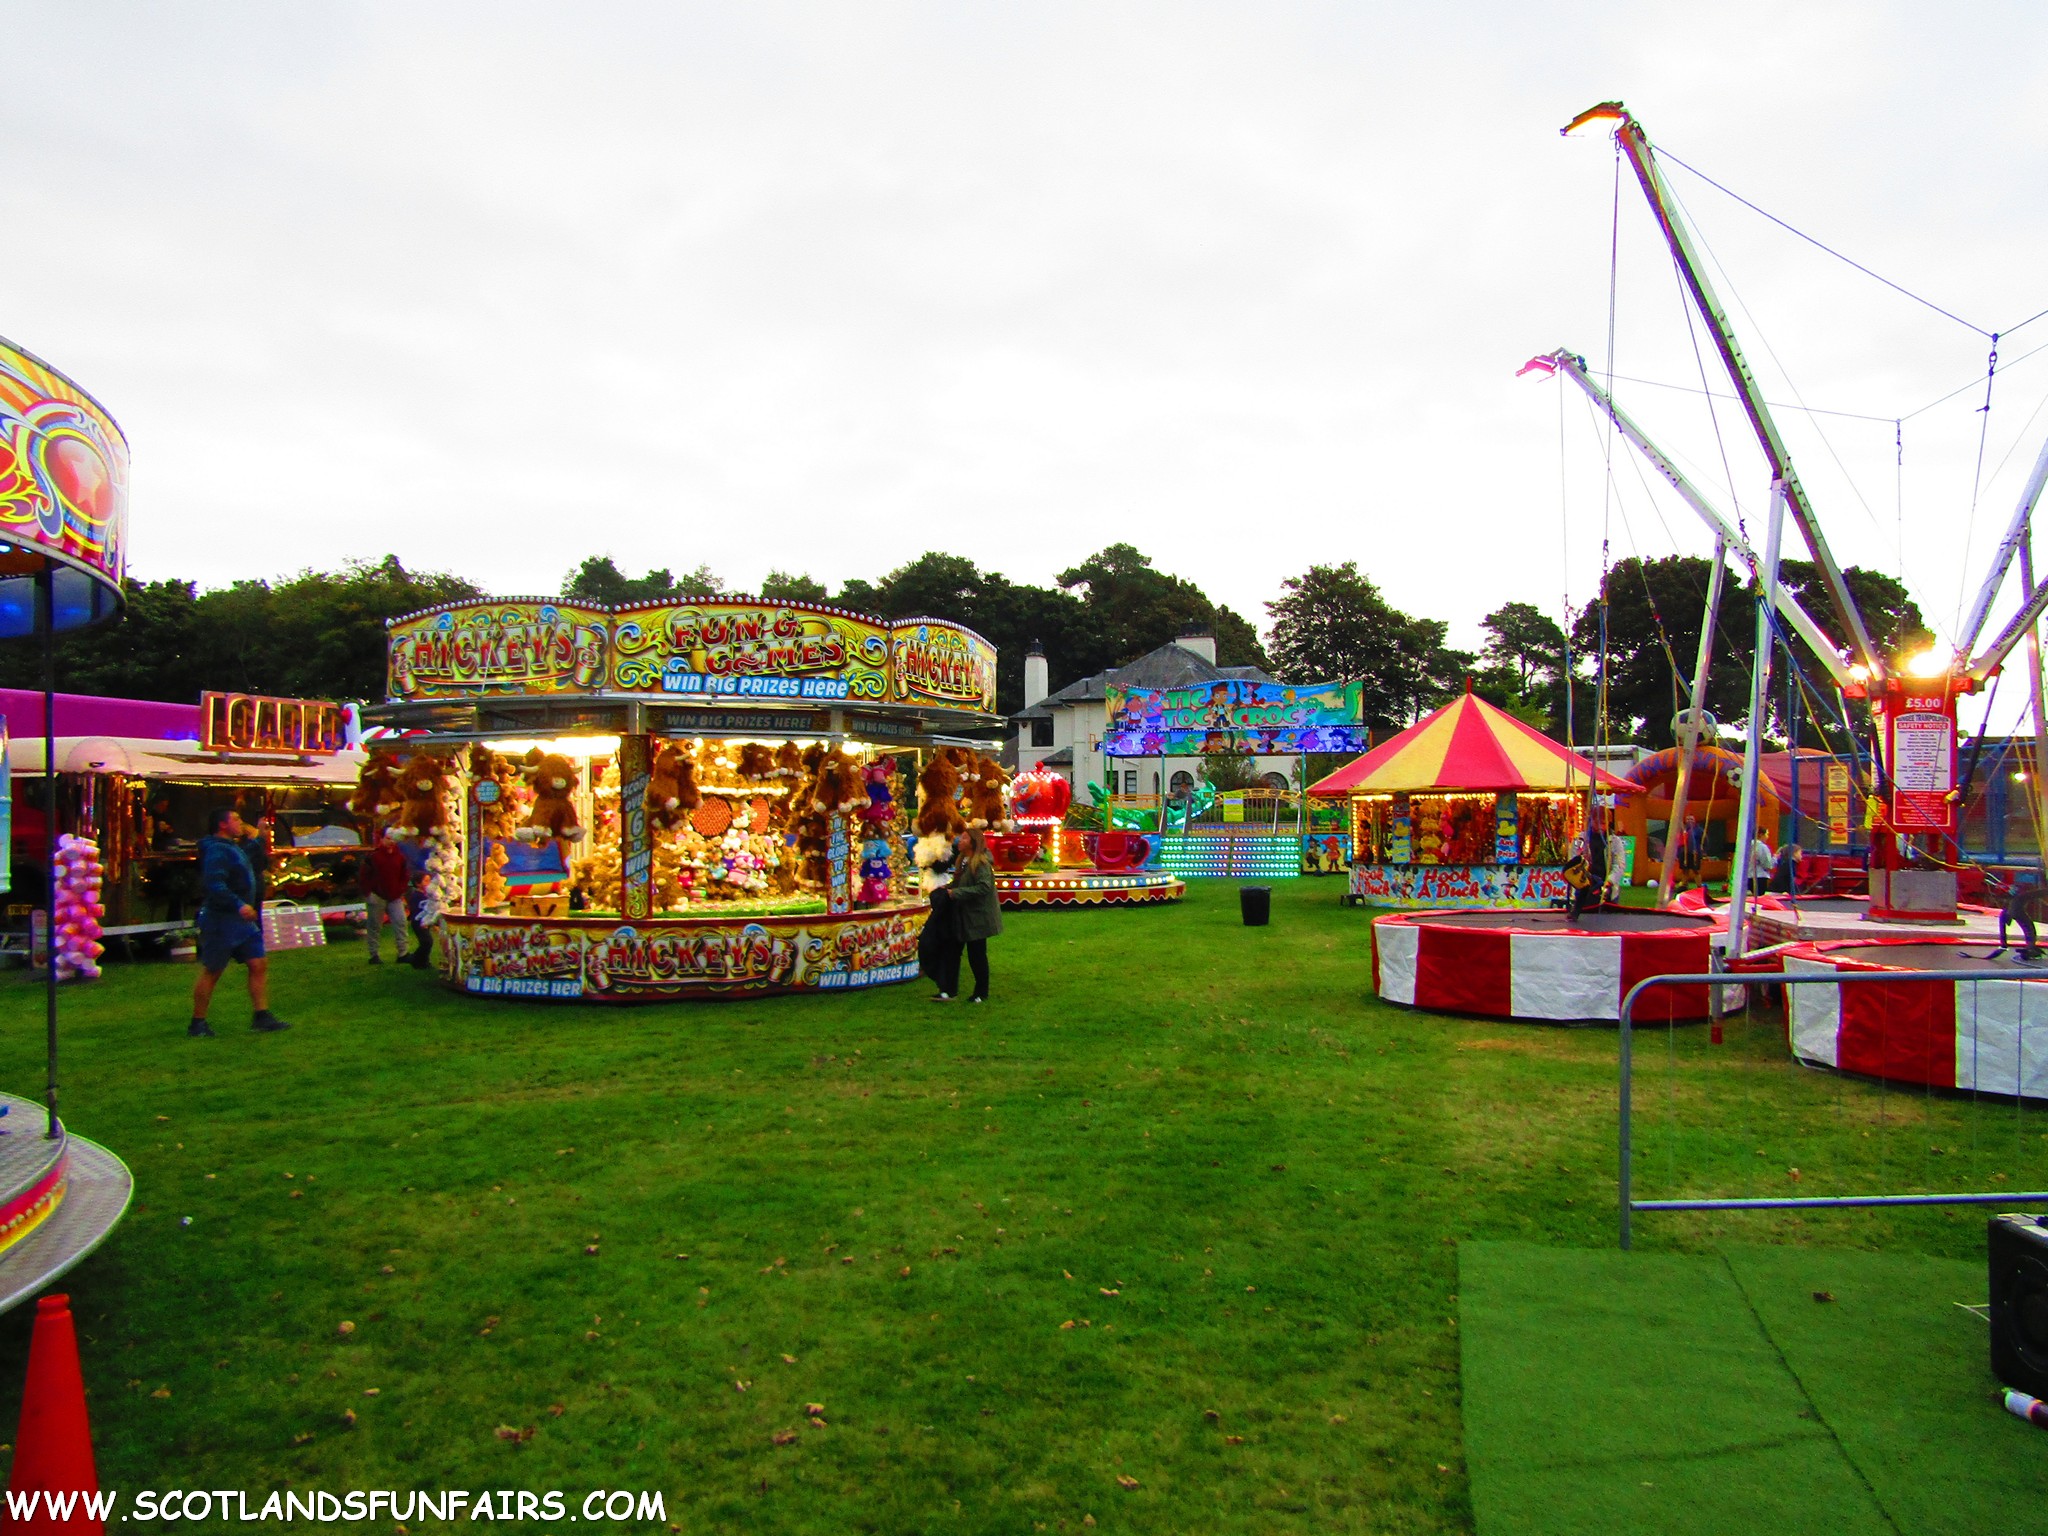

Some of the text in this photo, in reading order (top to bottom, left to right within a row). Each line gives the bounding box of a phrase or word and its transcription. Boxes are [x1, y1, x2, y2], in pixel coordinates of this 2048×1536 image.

[671, 607, 801, 654] FUN &
[705, 633, 849, 678] GAMES
[705, 676, 735, 694] BIG
[1166, 689, 1206, 708] TIC
[1905, 697, 1941, 709] £5.00
[205, 693, 341, 752] LOADED
[667, 714, 811, 729] WIN BIG PRIZES HERE!
[1162, 704, 1300, 727] TOC CROC
[625, 793, 644, 812] OVE
[632, 809, 644, 837] 6
[625, 850, 651, 877] WIN
[1358, 868, 1385, 884] Hook
[1422, 866, 1472, 885] Hook
[1527, 868, 1566, 884] Hoo
[1364, 880, 1390, 897] Duck
[1416, 881, 1480, 899] A Duck
[1520, 881, 1568, 899] A Duc
[474, 926, 526, 959] FUN
[839, 919, 890, 956] FUN
[492, 943, 582, 979] GAMES
[483, 978, 501, 993] BIG
[850, 970, 869, 984] BIG
